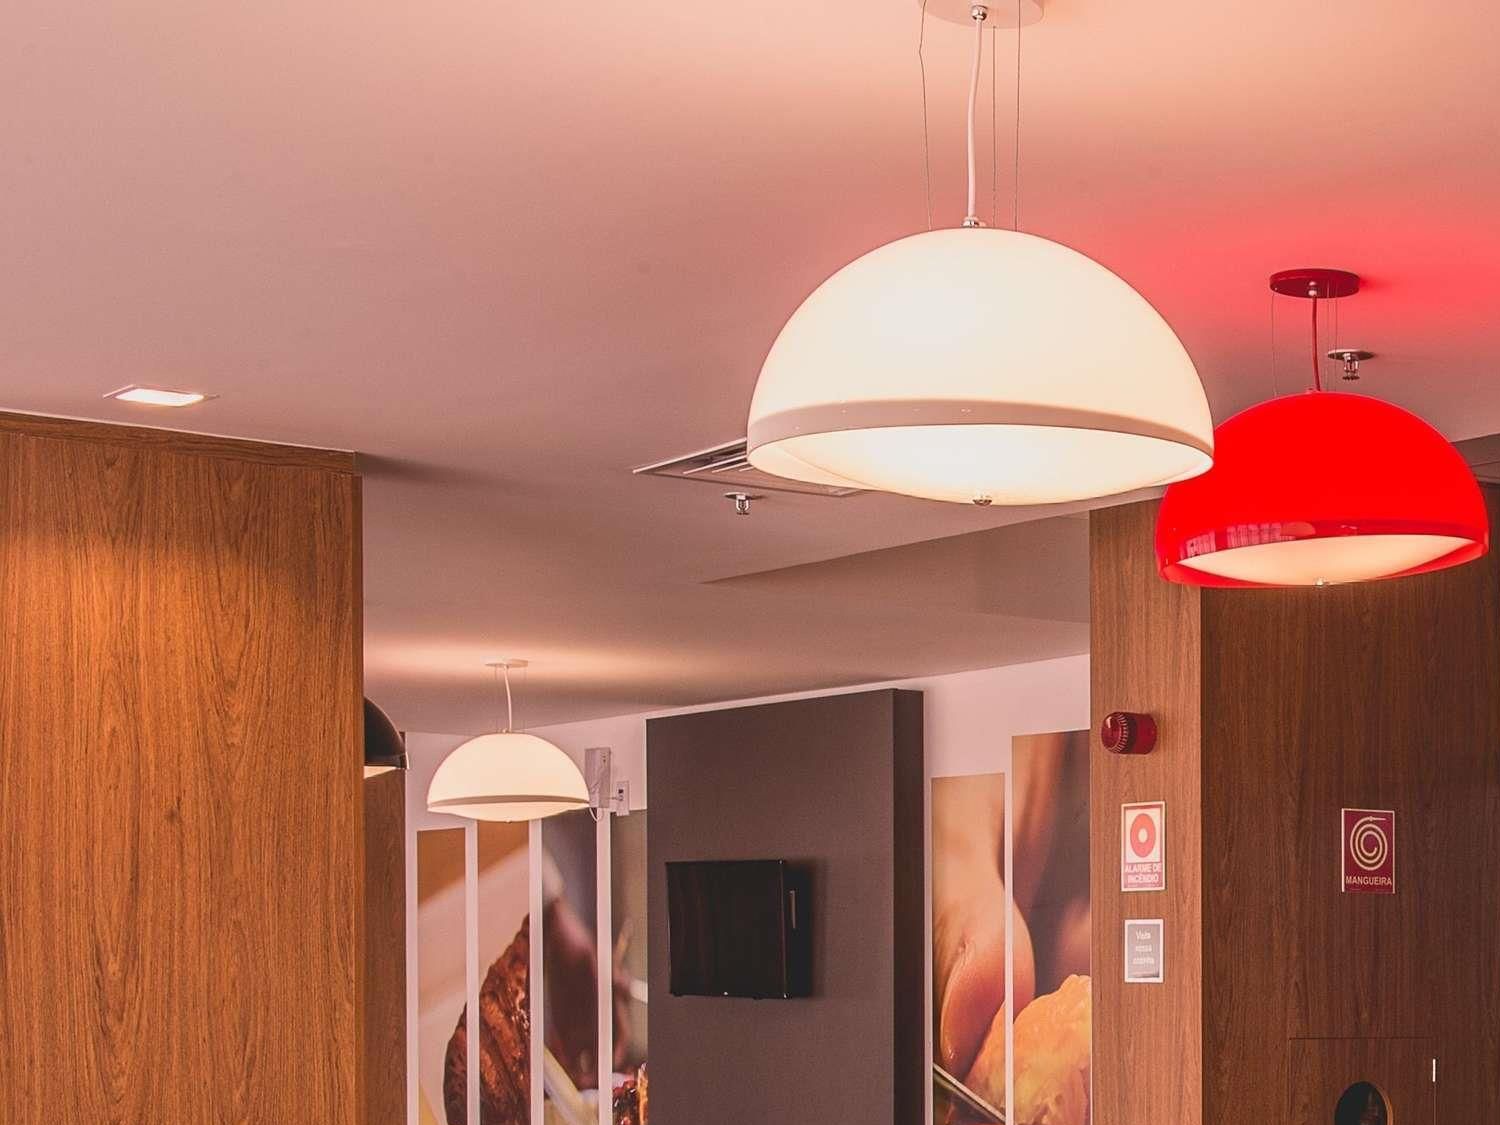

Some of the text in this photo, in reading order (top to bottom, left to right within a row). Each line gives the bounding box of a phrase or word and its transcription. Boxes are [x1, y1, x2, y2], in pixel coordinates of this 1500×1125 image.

[1125, 863, 1162, 873] ALARME DE
[1345, 875, 1393, 886] MANGUEIRA
